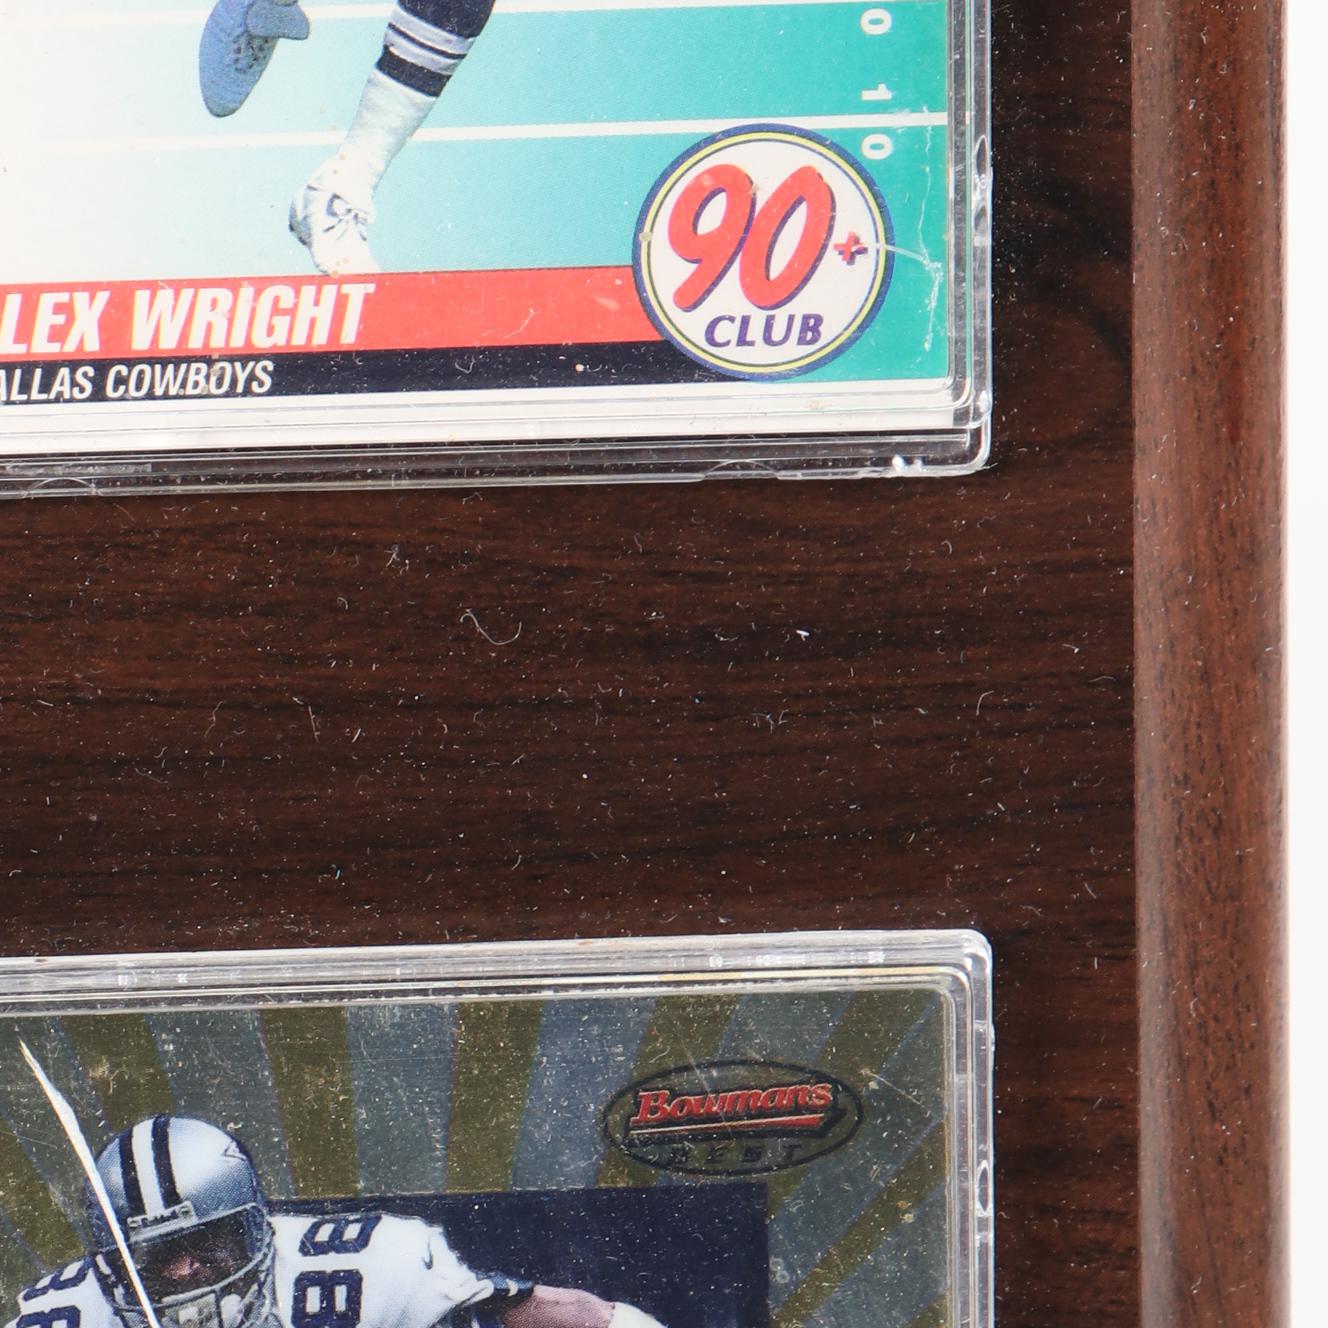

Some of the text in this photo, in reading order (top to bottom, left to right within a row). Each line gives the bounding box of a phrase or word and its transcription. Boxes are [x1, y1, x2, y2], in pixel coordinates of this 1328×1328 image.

[130, 283, 376, 351] WRIGHT
[703, 313, 825, 349] CLUB
[105, 359, 275, 399] COWBOYS
